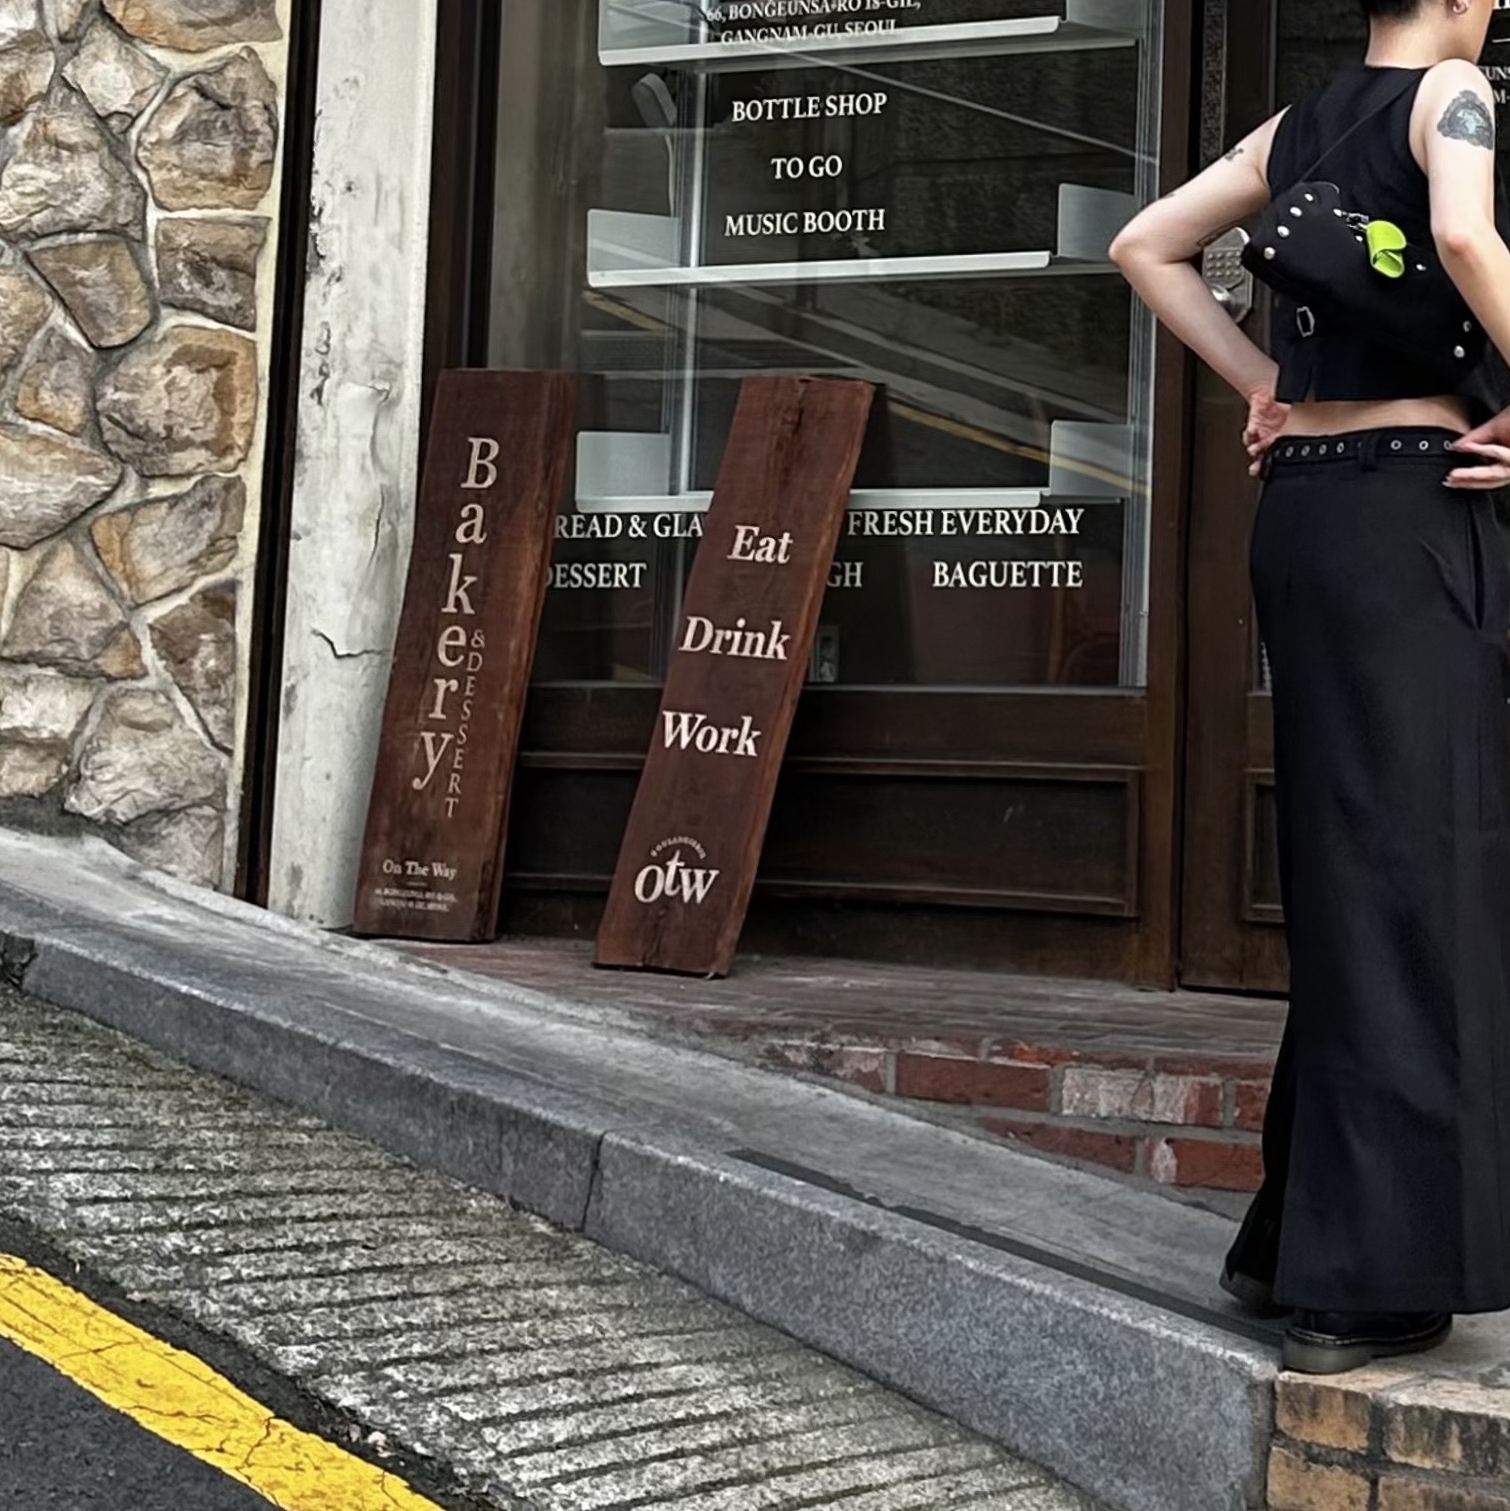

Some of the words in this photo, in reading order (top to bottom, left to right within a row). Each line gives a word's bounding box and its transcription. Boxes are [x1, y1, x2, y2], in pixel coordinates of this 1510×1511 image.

[731, 95, 821, 124] BOTTLE
[825, 91, 889, 119] SHOP
[771, 156, 804, 181] TO
[807, 154, 843, 179] GO
[724, 212, 799, 238] MUSIC
[802, 208, 886, 234] BOOTH
[555, 513, 623, 539] READ
[628, 514, 648, 538] &
[653, 512, 704, 538] GLA
[848, 509, 934, 536] FRESH
[940, 508, 1085, 536] EVERYDAY
[727, 525, 794, 565] Eat
[932, 561, 1084, 588] BAGUETTE
[411, 436, 501, 791] Bakery
[678, 615, 790, 661] Drink
[661, 709, 763, 758] Work
[382, 858, 402, 875] On
[404, 860, 430, 877] The
[431, 861, 458, 881] Way
[634, 849, 720, 905] otw
